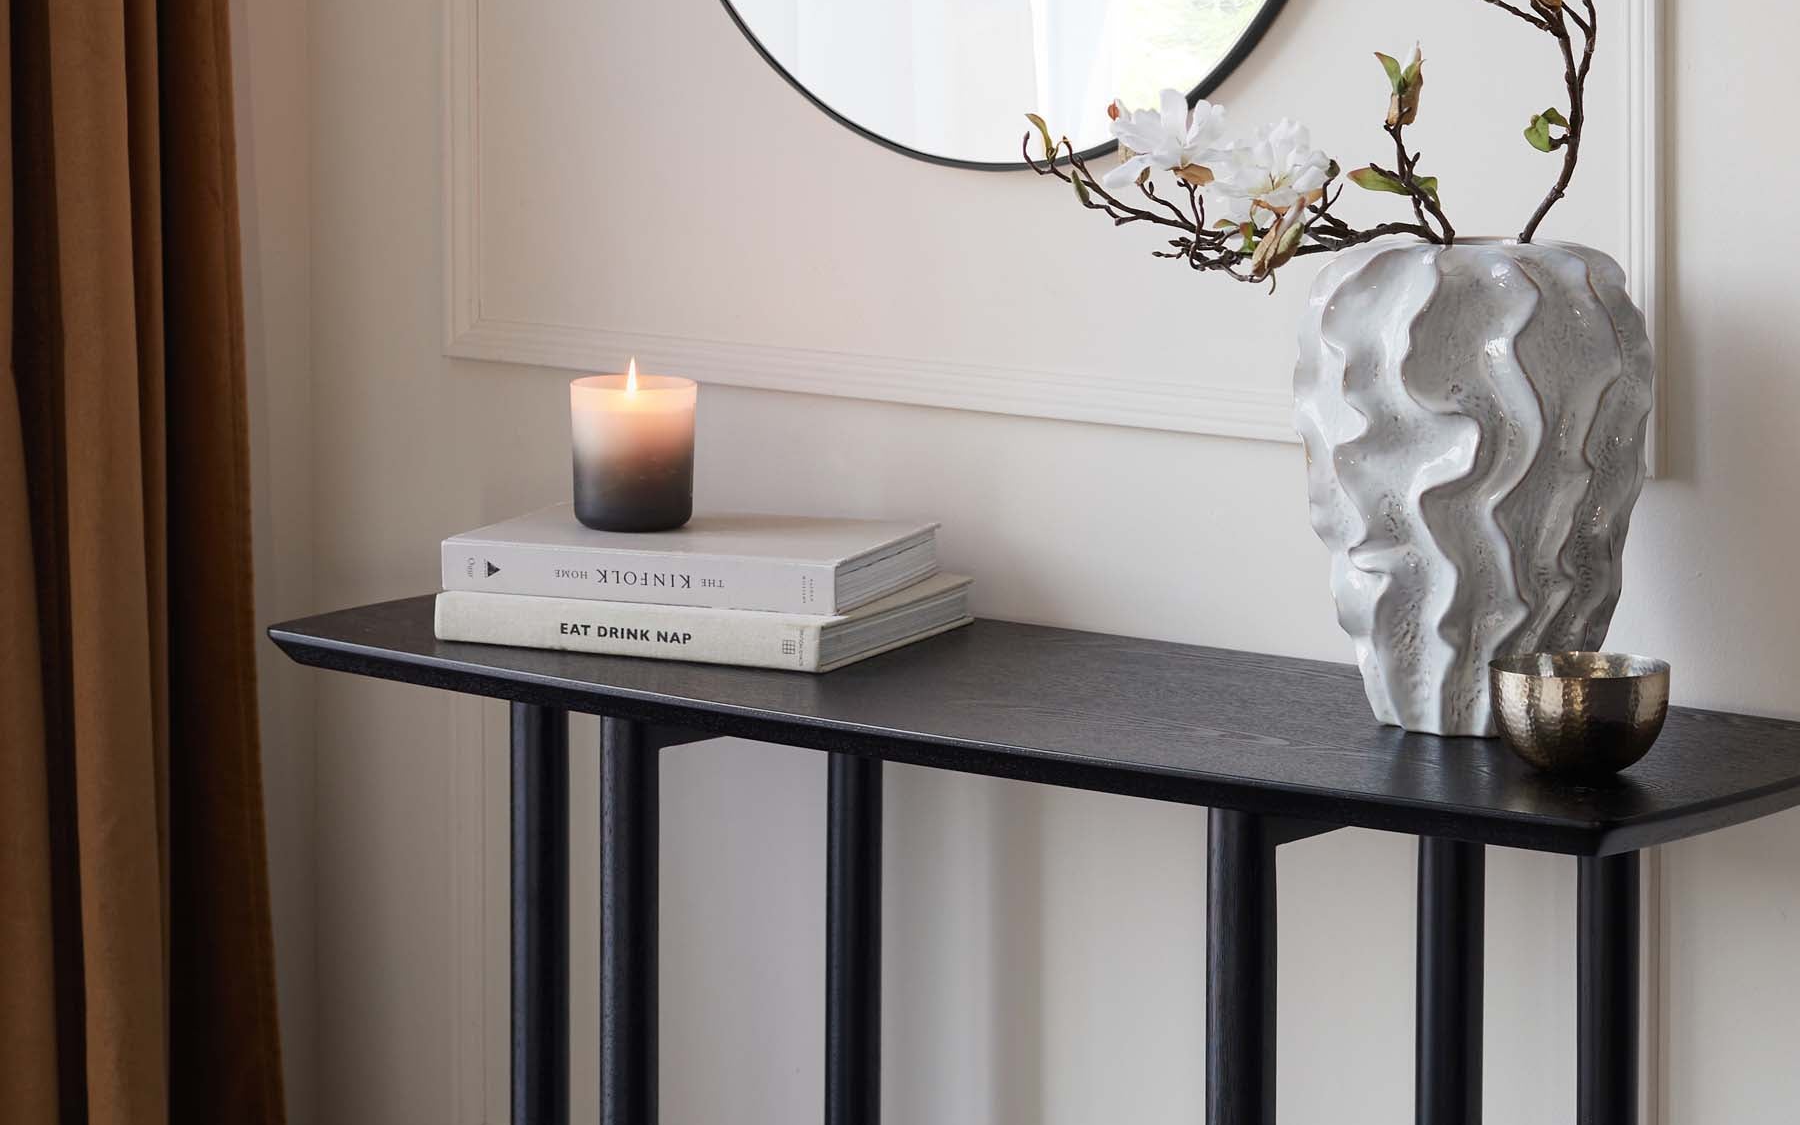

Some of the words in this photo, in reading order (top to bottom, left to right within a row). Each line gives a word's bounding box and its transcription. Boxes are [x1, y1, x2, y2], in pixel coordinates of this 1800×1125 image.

[554, 569, 588, 580] HOME
[596, 569, 692, 589] KINFOLK
[701, 578, 725, 589] THE
[560, 622, 592, 636] EAT
[597, 625, 650, 642] DRINK
[656, 630, 692, 645] NAP
